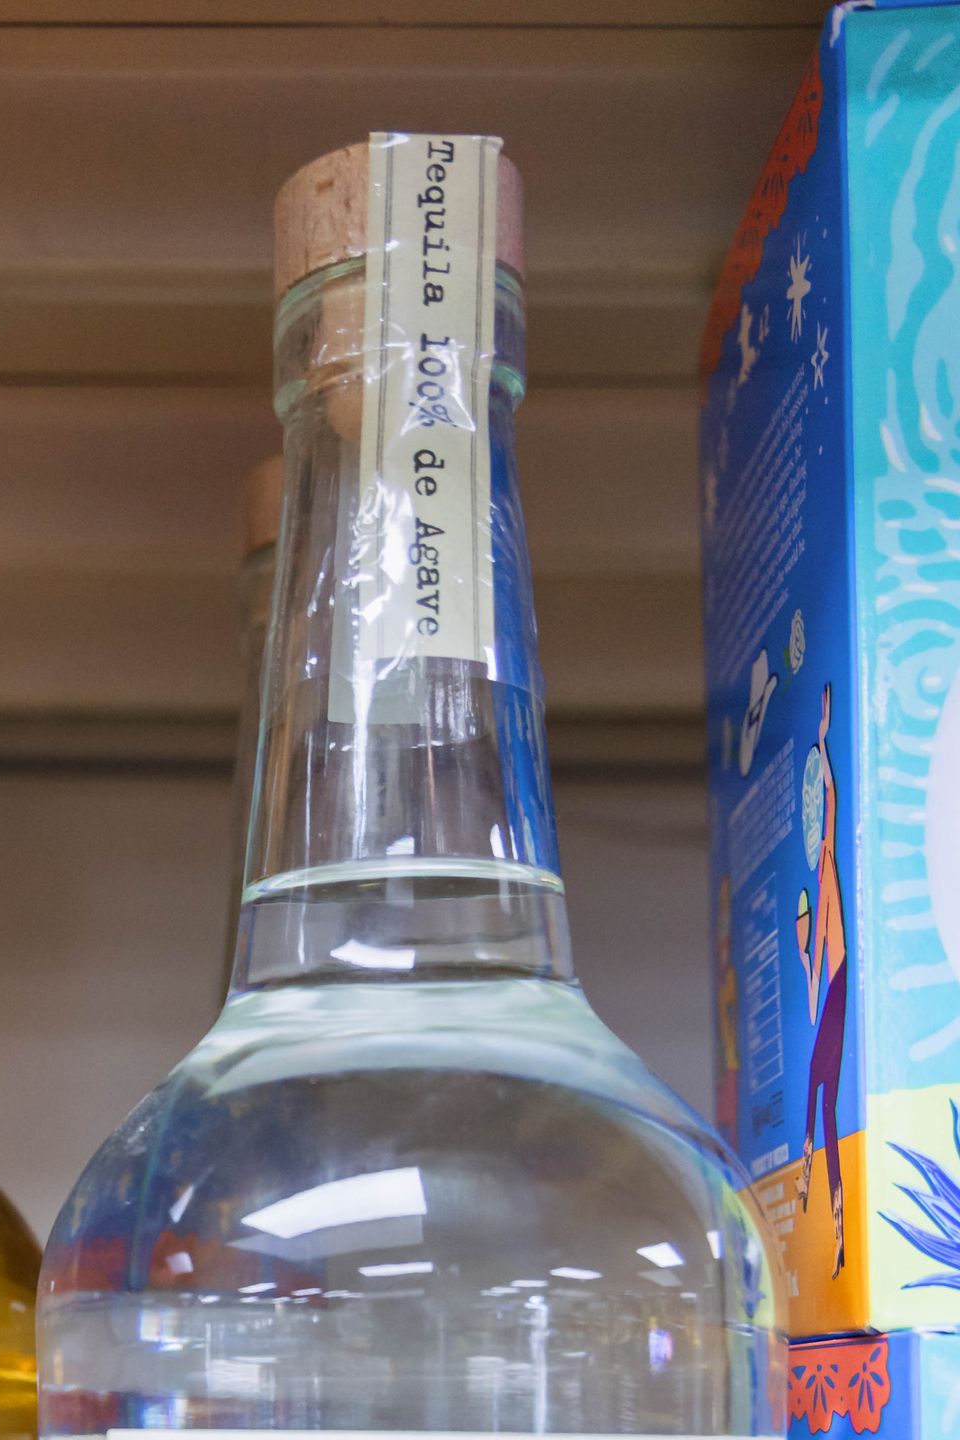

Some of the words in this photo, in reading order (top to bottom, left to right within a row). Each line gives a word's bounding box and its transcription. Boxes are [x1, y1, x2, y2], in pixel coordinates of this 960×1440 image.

[417, 140, 454, 307] Tequila
[408, 333, 456, 428] 100%
[412, 448, 445, 497] de
[408, 515, 446, 638] Agave
